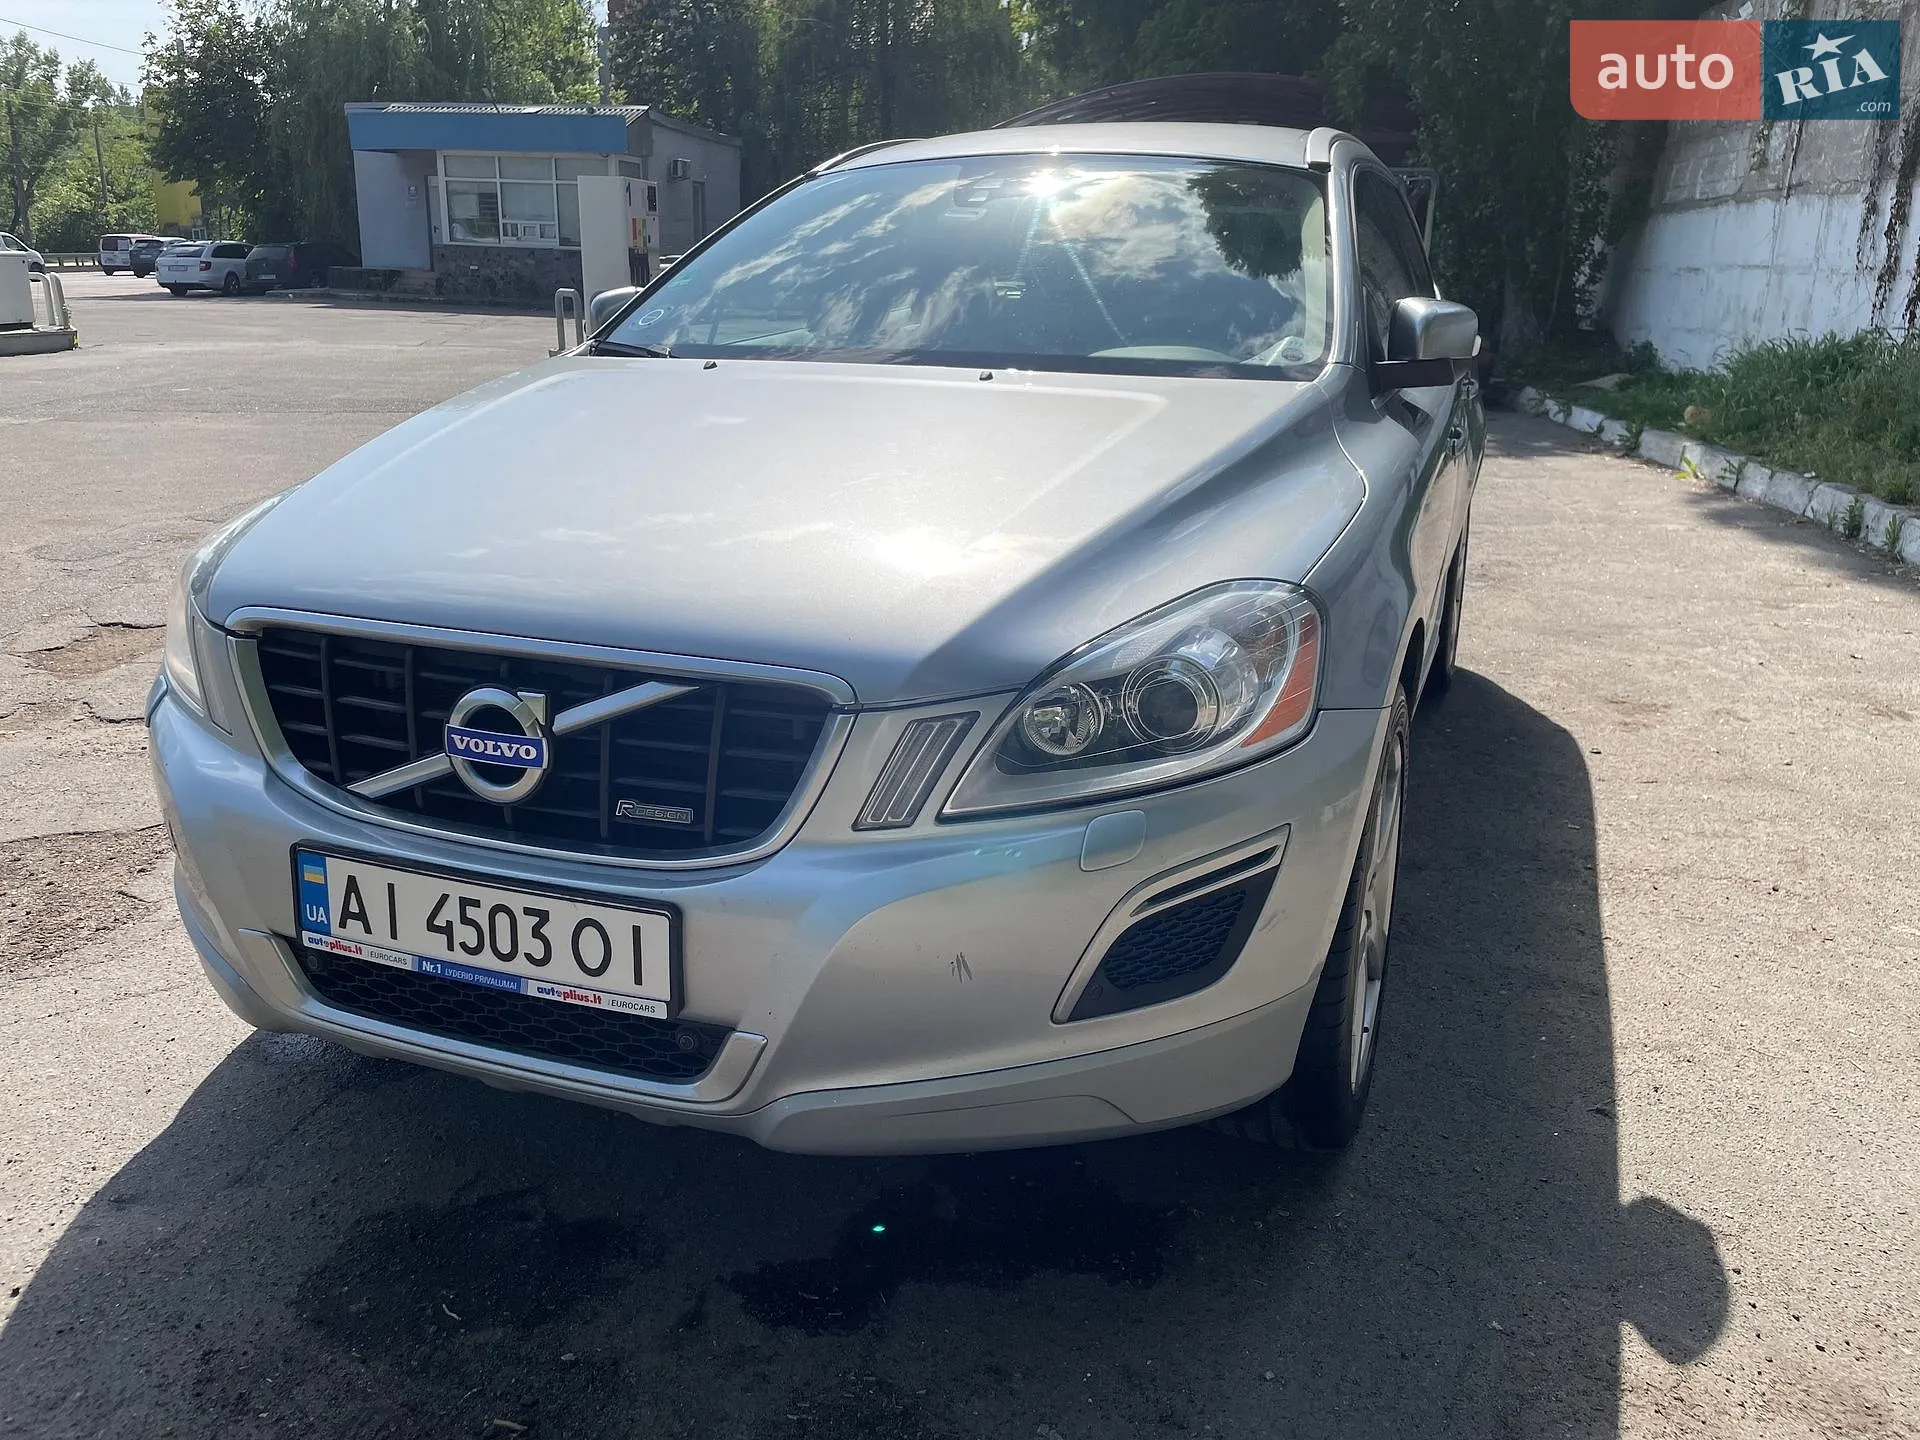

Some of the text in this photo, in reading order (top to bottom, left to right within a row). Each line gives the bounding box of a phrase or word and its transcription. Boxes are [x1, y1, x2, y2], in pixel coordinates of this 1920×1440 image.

[451, 735, 537, 760] VOLVO
[306, 903, 328, 925] UA
[338, 874, 643, 986] AI 4503 OI
[308, 935, 363, 956] autoplius.lt
[370, 950, 408, 966] EUROCARS
[422, 960, 442, 974] Nr.1
[536, 985, 602, 1005] autoplius.lt
[611, 999, 656, 1014] EUROCARS
